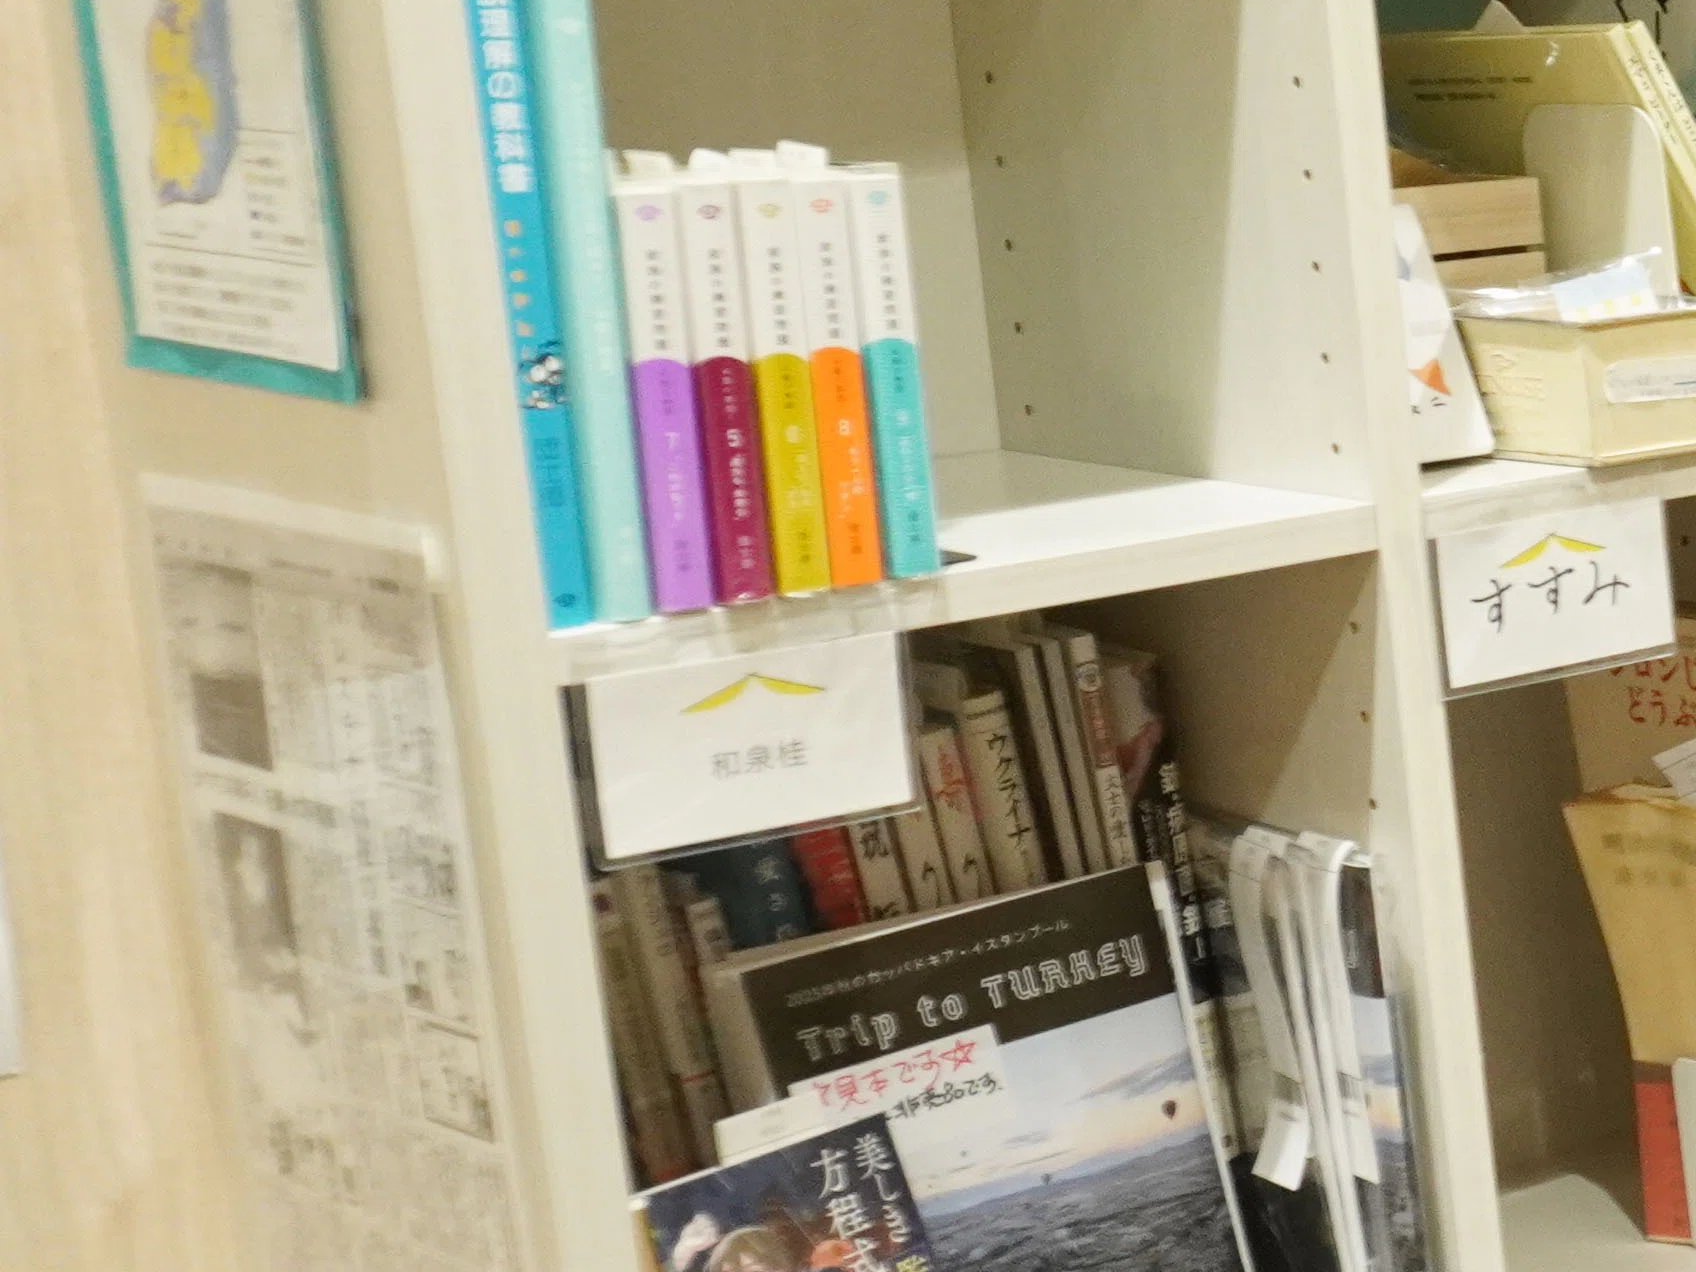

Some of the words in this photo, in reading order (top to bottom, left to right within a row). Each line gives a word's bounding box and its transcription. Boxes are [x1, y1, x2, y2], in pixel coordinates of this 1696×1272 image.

[1470, 562, 1632, 633] すすみ
[711, 742, 808, 780] 和泉桂
[800, 1007, 899, 1061] Trip
[918, 992, 971, 1030] to
[980, 932, 1148, 1011] TURKEY
[855, 1133, 907, 1245] 美しき
